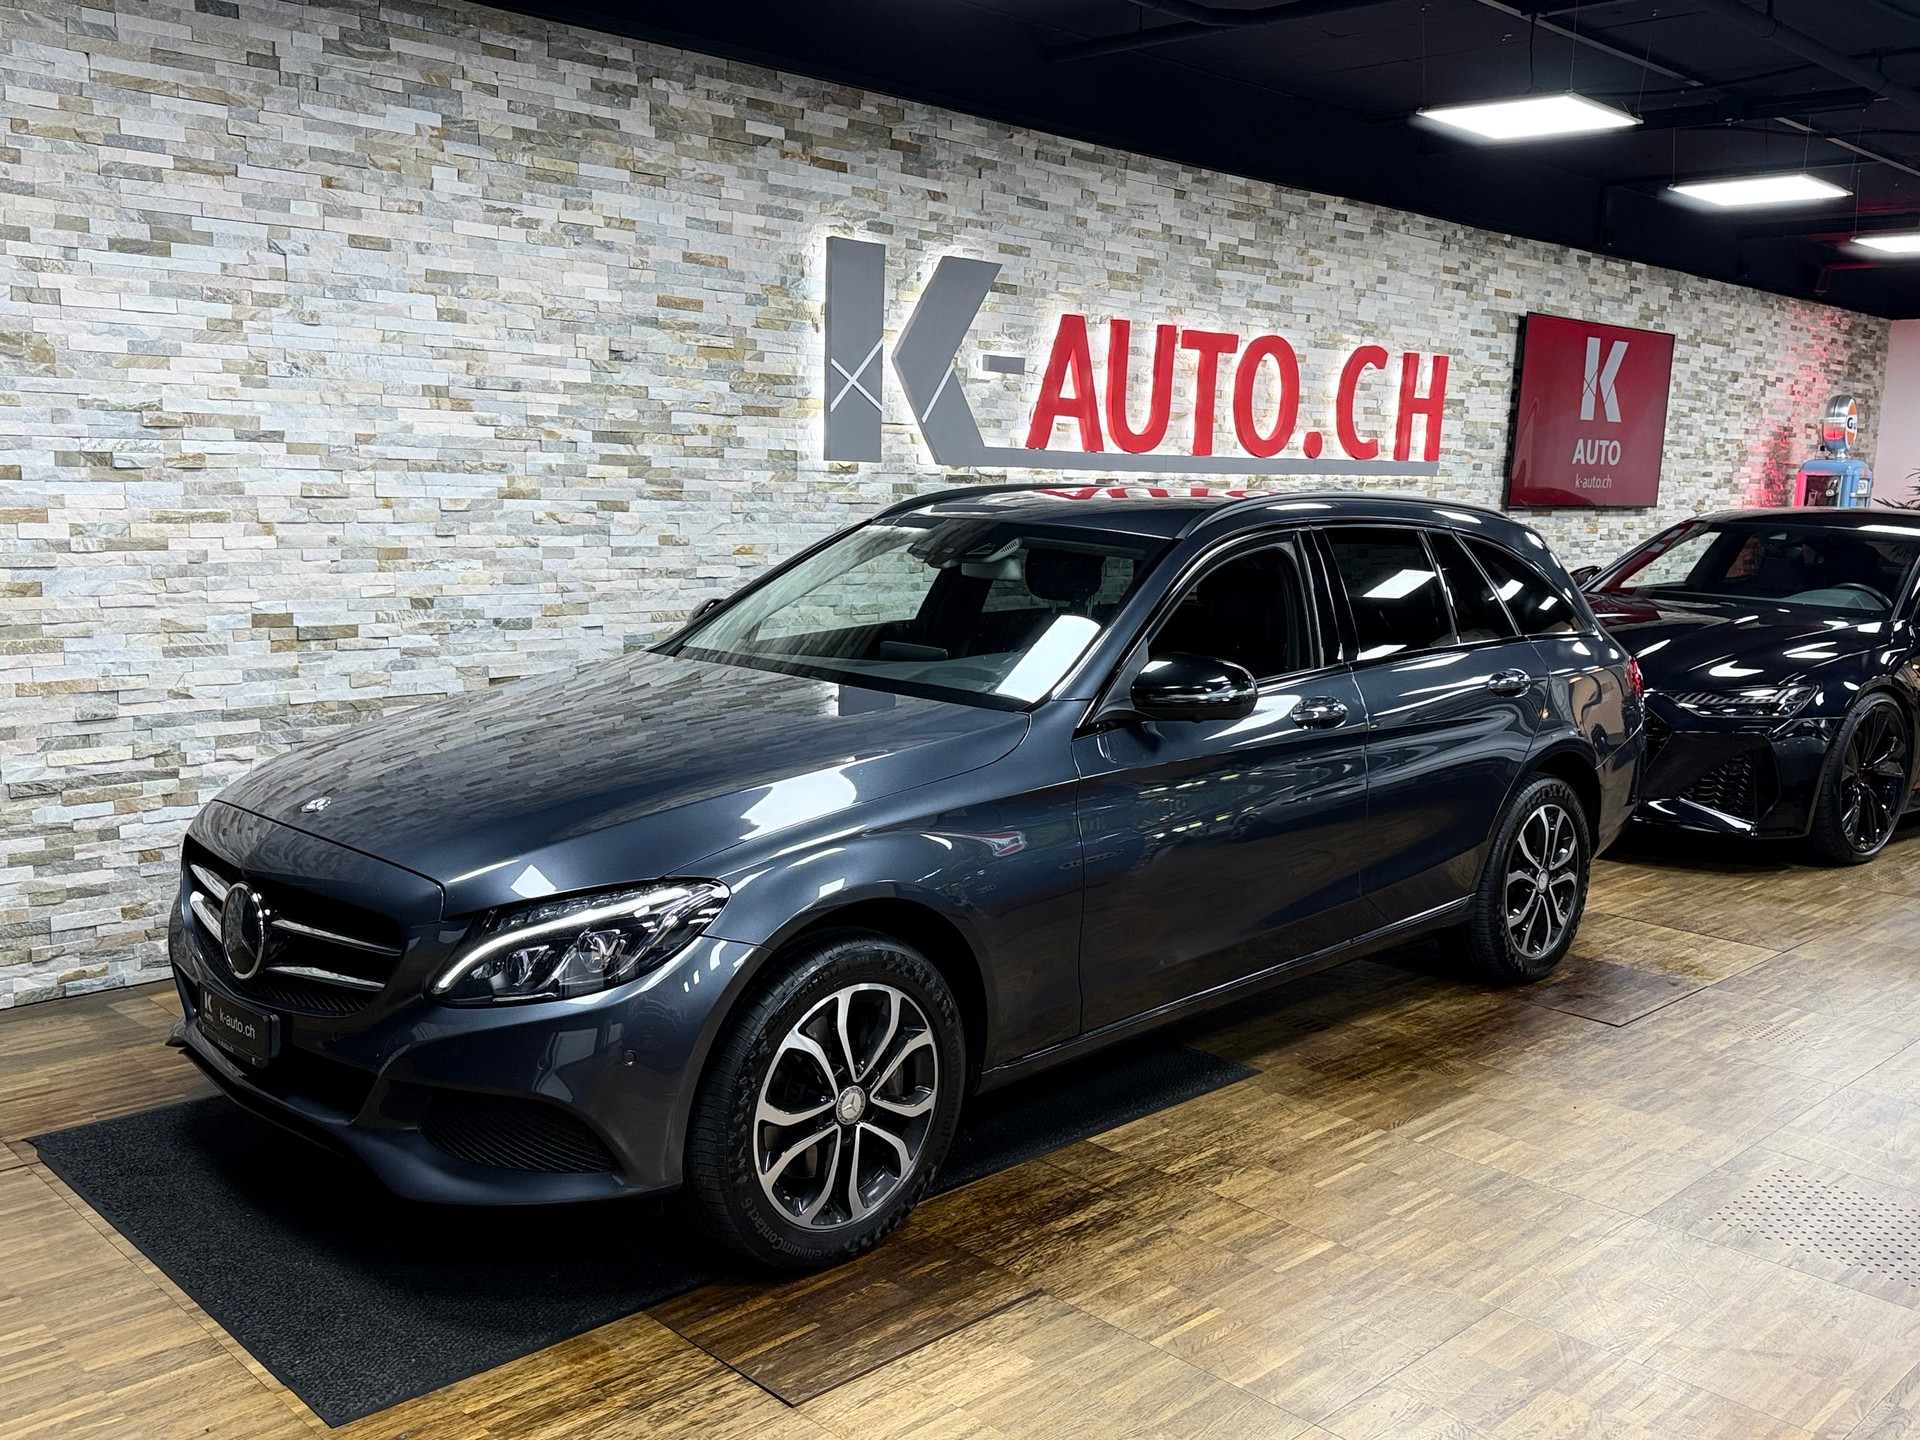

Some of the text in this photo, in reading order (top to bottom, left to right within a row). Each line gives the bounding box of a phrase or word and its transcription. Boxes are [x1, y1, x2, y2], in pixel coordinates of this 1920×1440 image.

[1580, 336, 1629, 423] K
[1571, 439, 1621, 466] AUTO
[1574, 473, 1612, 489] k-auto.ch
[204, 991, 213, 1013] K
[219, 1007, 256, 1040] k-auto.ch
